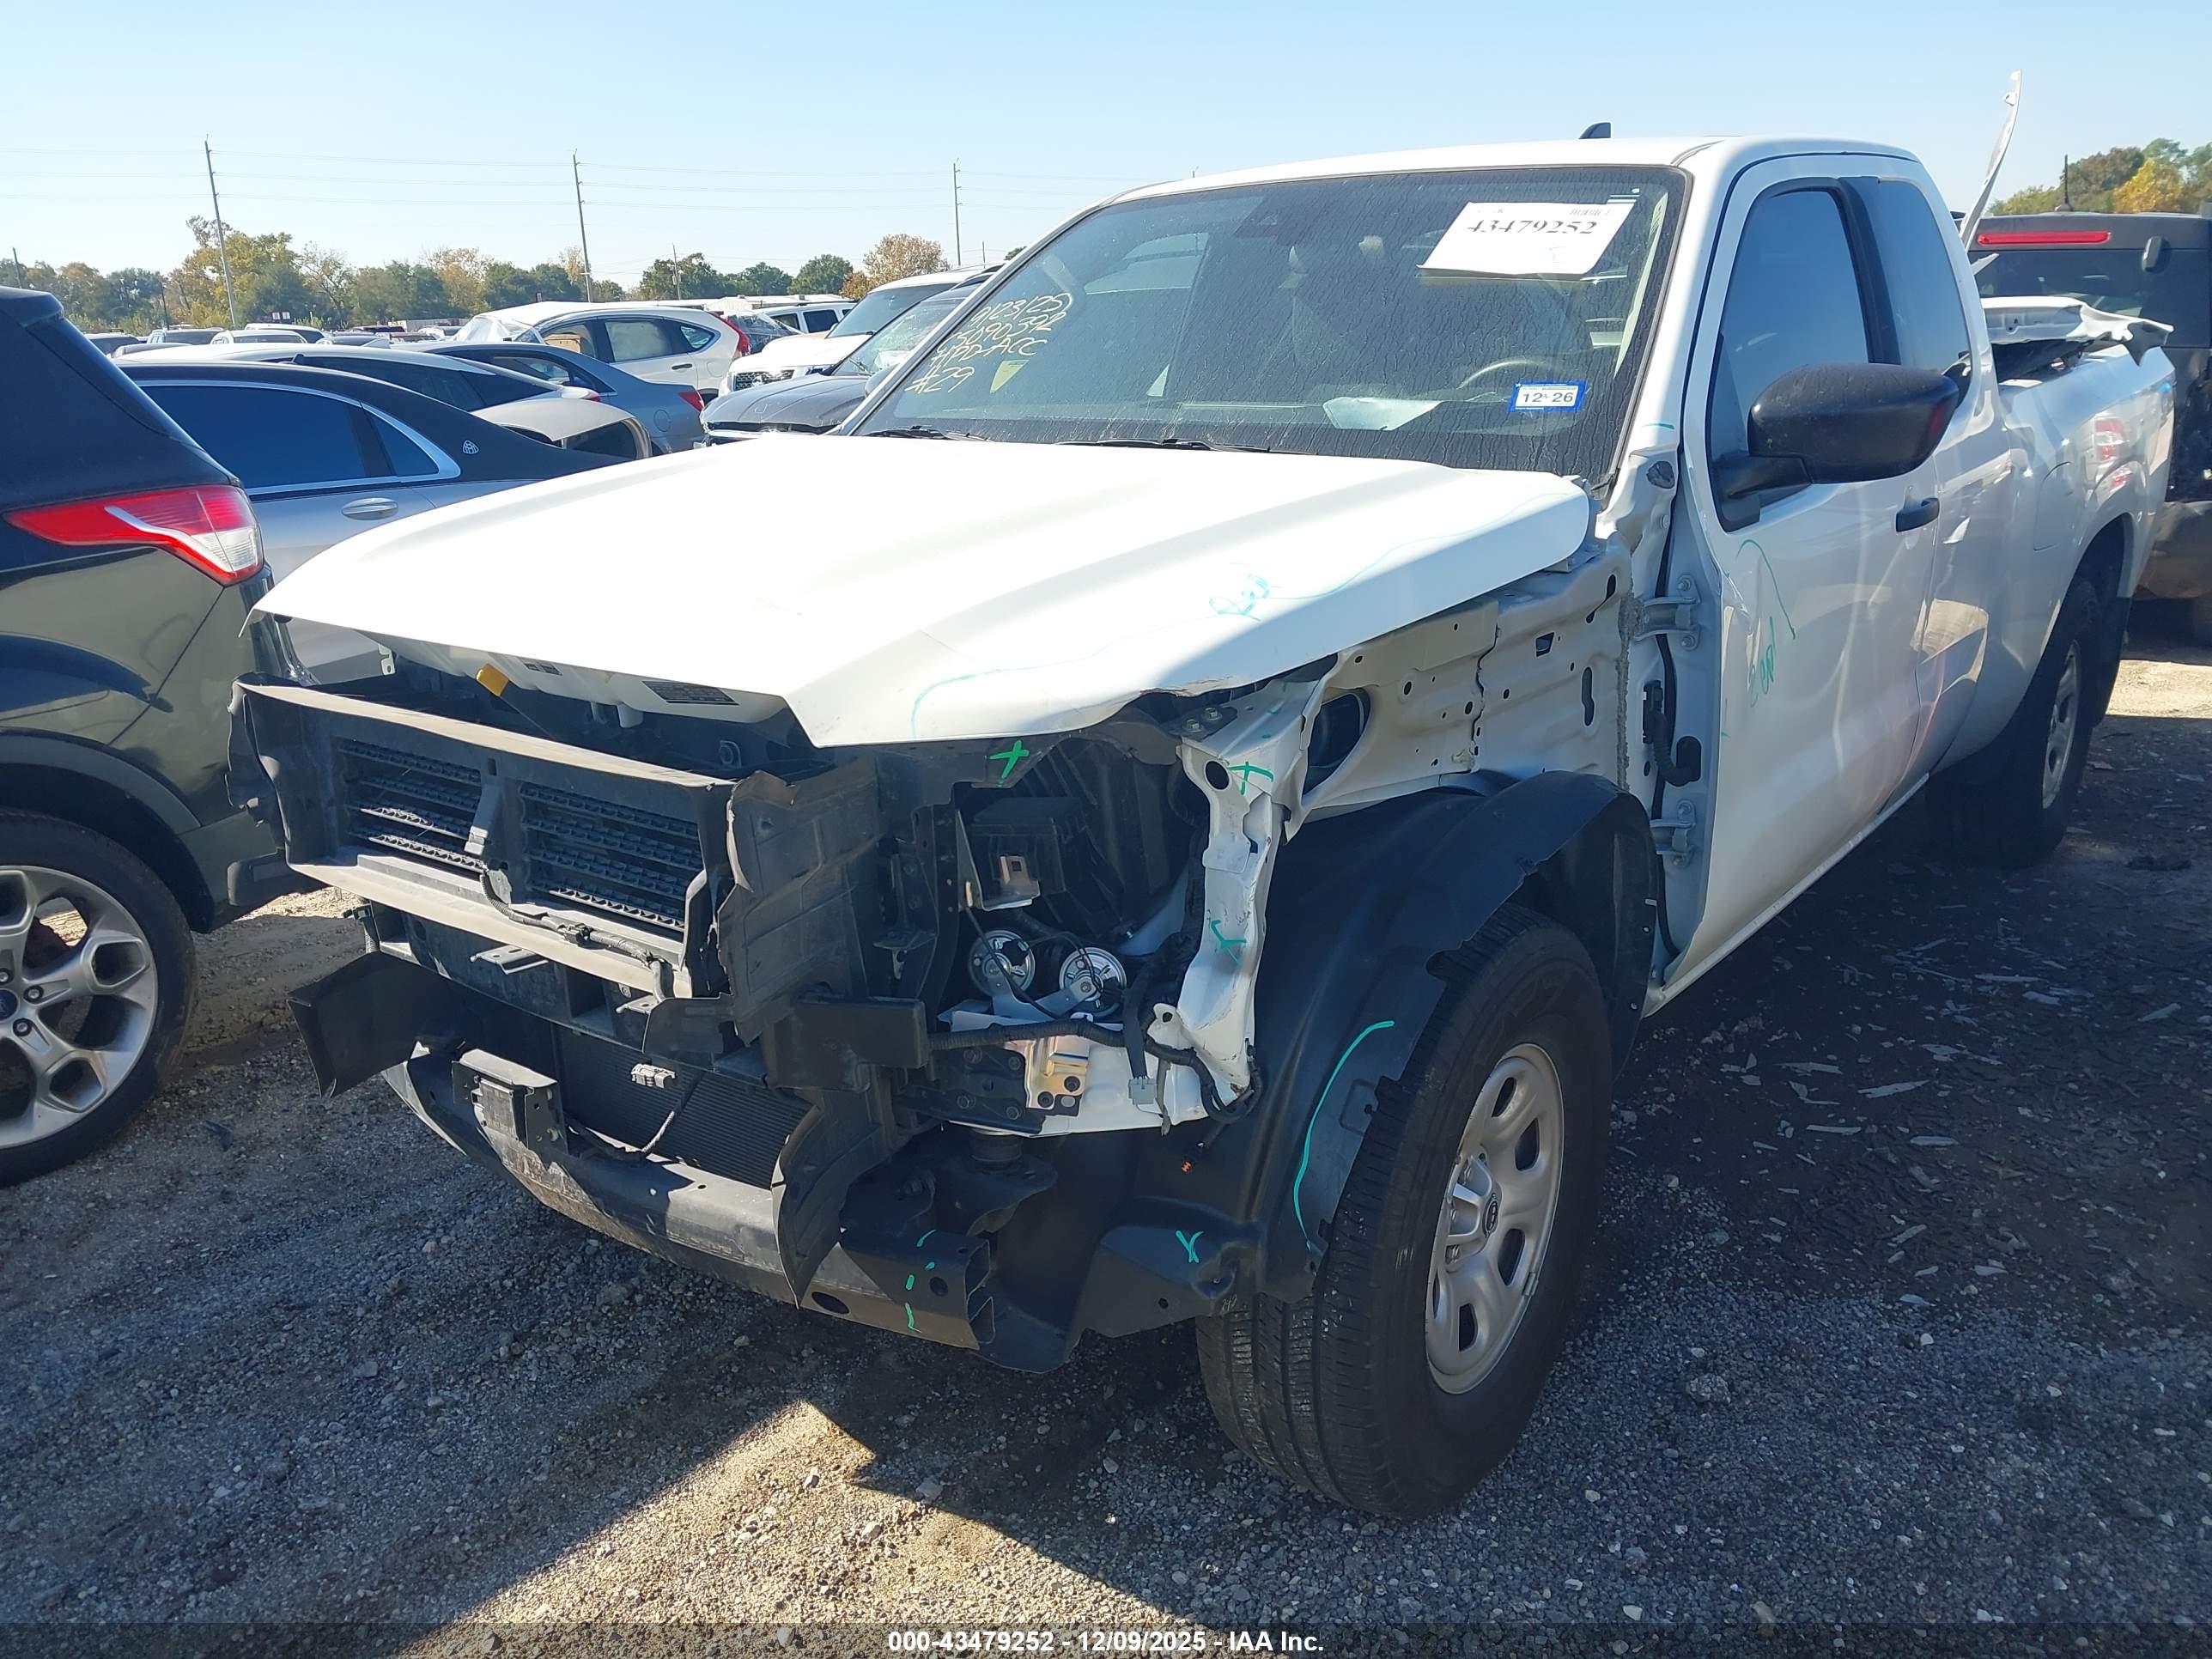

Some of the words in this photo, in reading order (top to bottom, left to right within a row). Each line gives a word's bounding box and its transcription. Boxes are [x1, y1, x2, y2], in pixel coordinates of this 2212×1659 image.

[1468, 220, 1597, 234] 43479252
[1522, 392, 1543, 403] 12
[1553, 392, 1574, 403] 26
